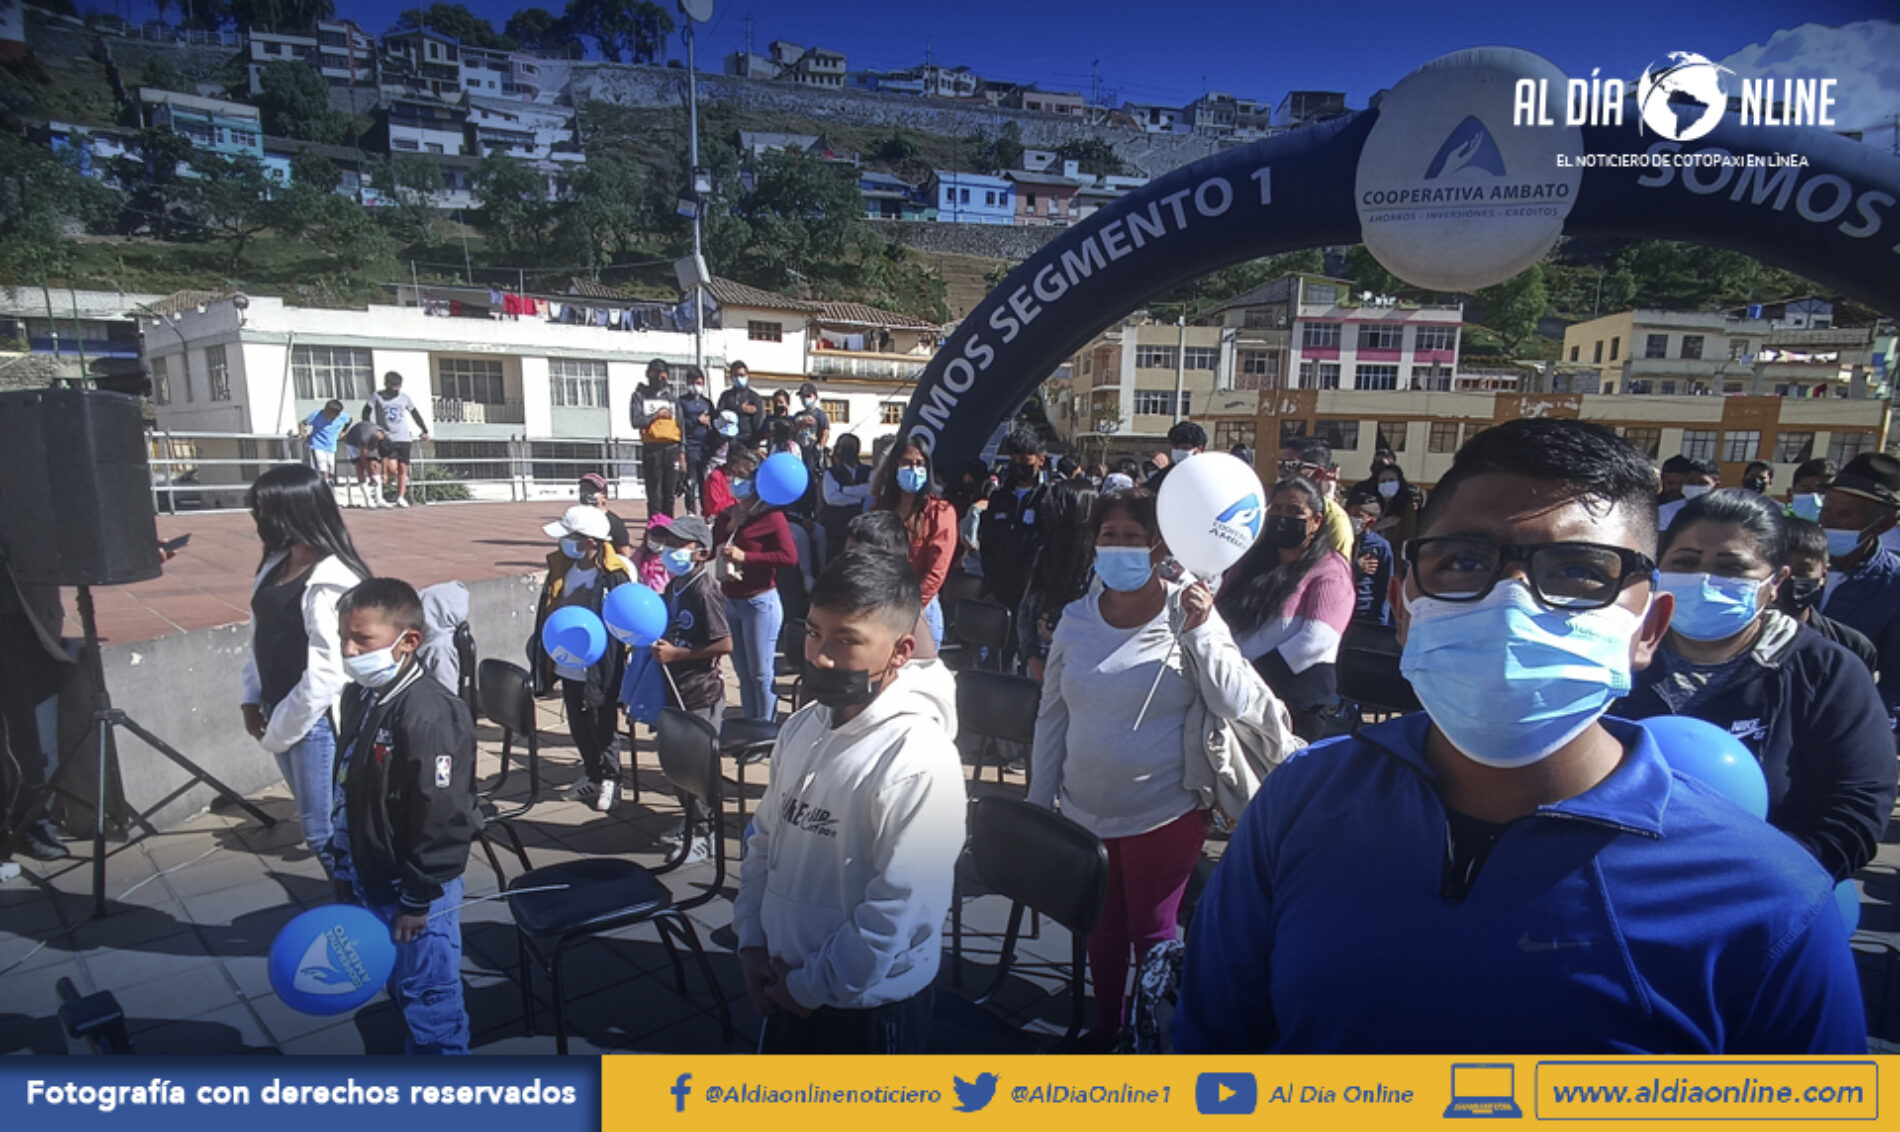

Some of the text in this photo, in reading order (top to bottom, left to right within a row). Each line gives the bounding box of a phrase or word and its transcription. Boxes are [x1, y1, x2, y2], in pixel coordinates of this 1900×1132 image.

[1362, 182, 1570, 206] COOPERATIVA AMBATO
[1368, 212, 1417, 224] AHORROS
[1426, 208, 1494, 221] INVERSIONES
[1637, 141, 1896, 238] SOMOS
[908, 166, 1272, 456] OMOS SEGMENTO 1
